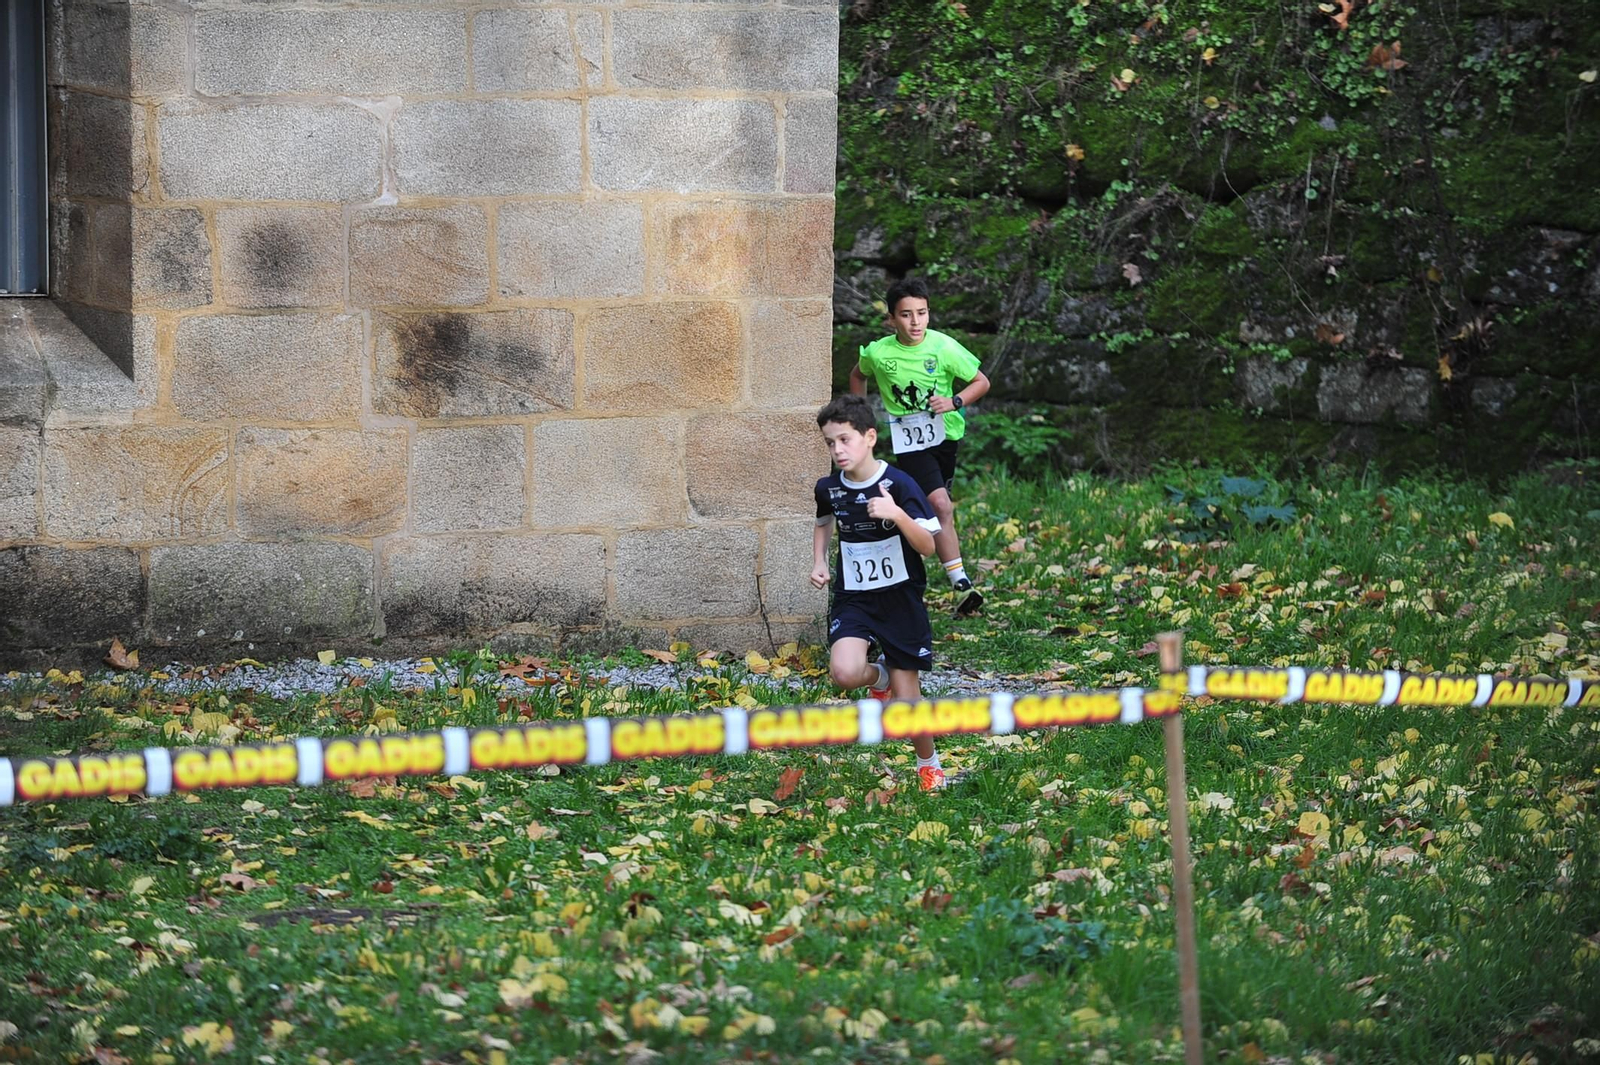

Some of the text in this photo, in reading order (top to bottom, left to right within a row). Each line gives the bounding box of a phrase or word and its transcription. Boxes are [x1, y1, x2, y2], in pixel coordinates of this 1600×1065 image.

[902, 423, 935, 447] 323
[852, 556, 894, 583] 326
[1205, 671, 1288, 698] GADIS
[1302, 674, 1384, 703] GADIS
[1397, 677, 1477, 705] GADIS
[1489, 682, 1567, 705] GADIS
[19, 760, 146, 796] GADIS
[174, 749, 299, 787] GADIS
[324, 739, 445, 777] GADIS
[471, 729, 587, 766] GADIS
[612, 720, 725, 756] GADIS
[749, 711, 858, 746] GADIS
[882, 700, 991, 736] GADIS
[1013, 695, 1121, 725] GADIS
